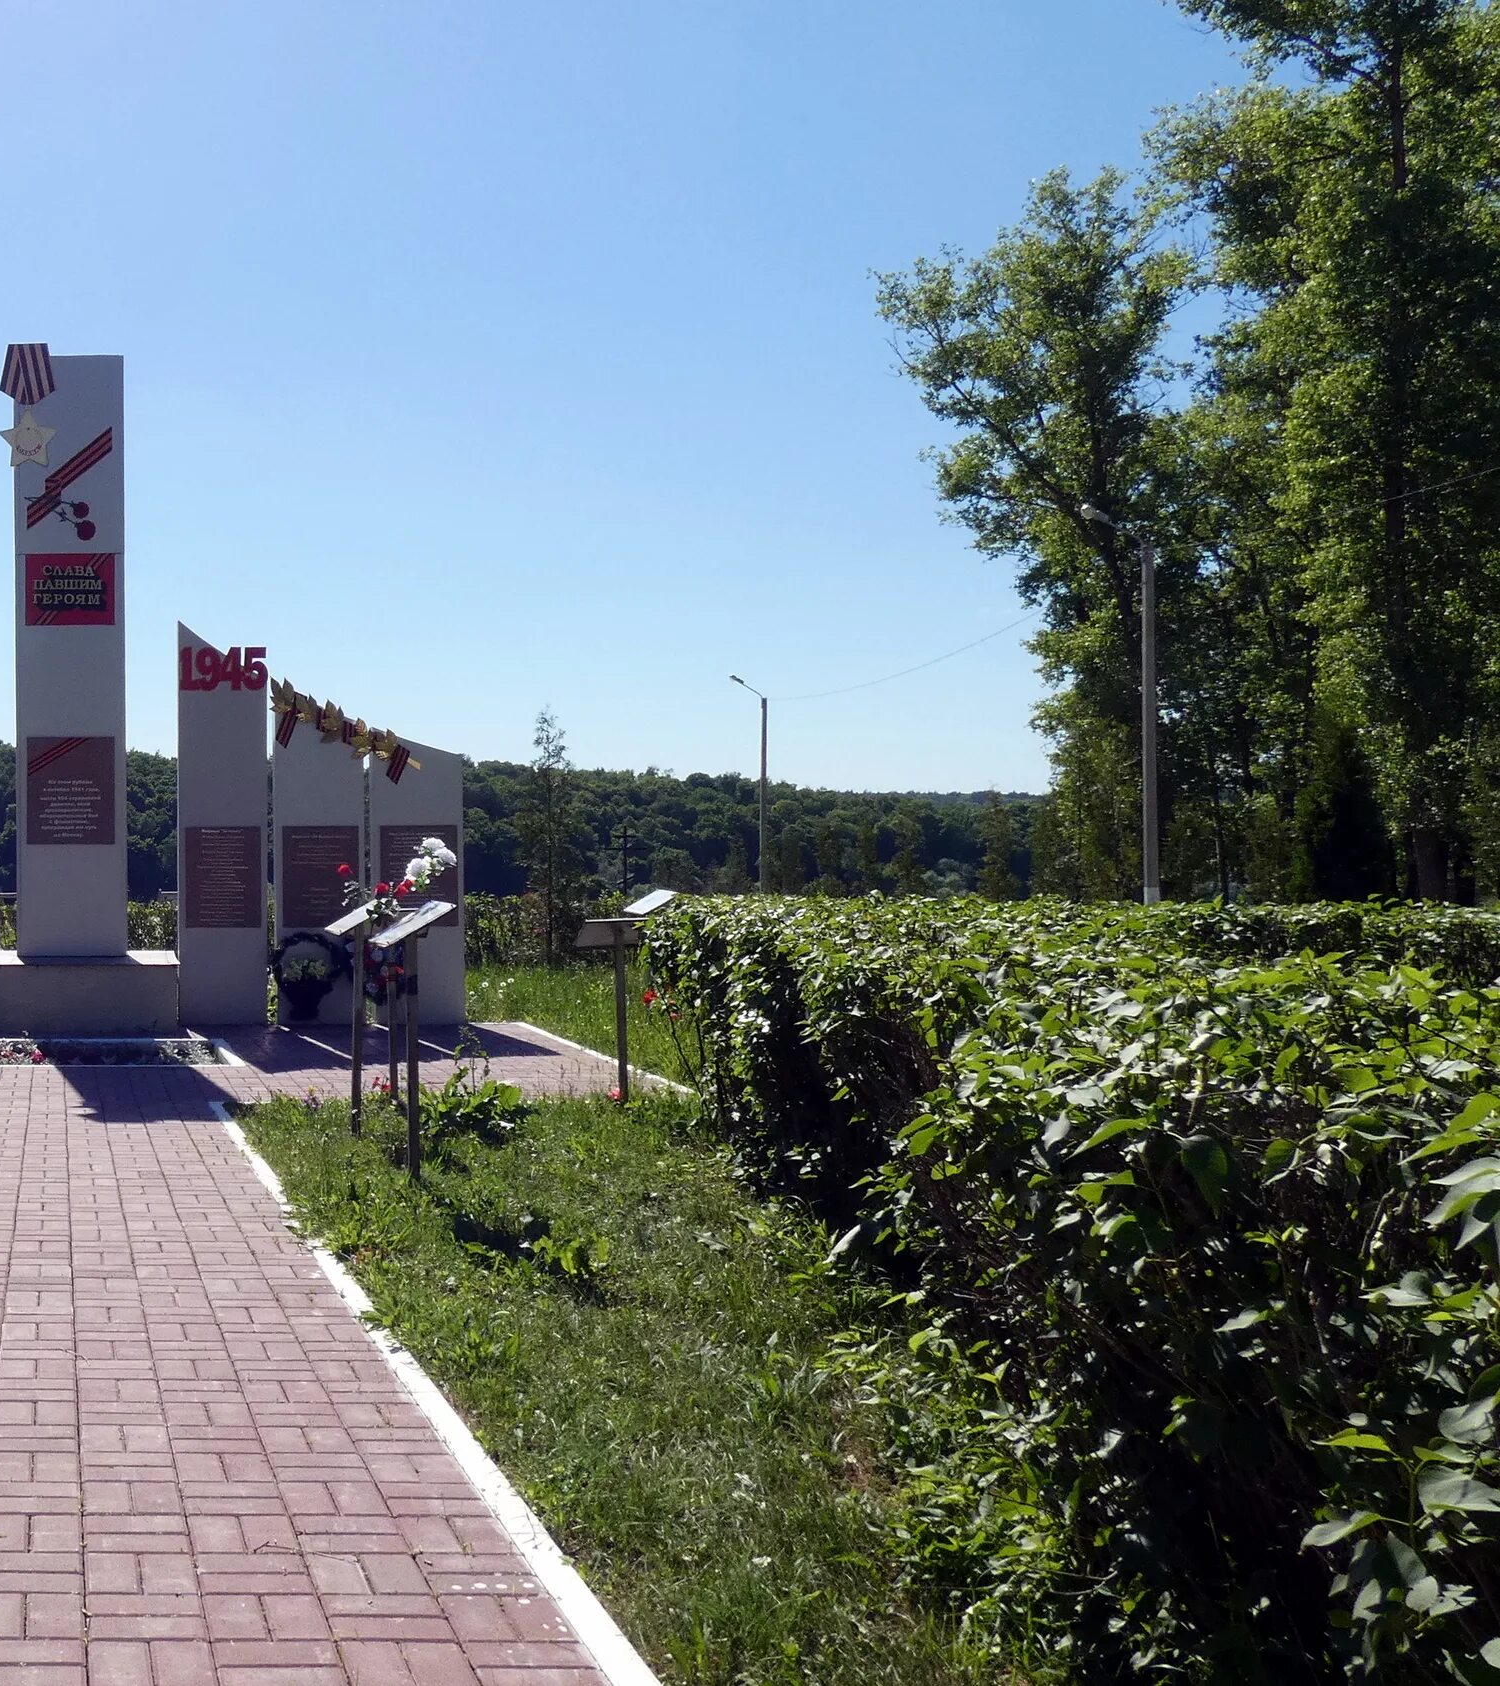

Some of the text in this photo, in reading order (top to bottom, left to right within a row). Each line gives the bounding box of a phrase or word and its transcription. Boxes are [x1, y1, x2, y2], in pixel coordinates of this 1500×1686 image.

[42, 565, 95, 576] СЛАВА
[33, 580, 102, 590] ПАВШИМ
[32, 594, 101, 605] ГЕРОЯМ
[179, 646, 268, 691] 1945
